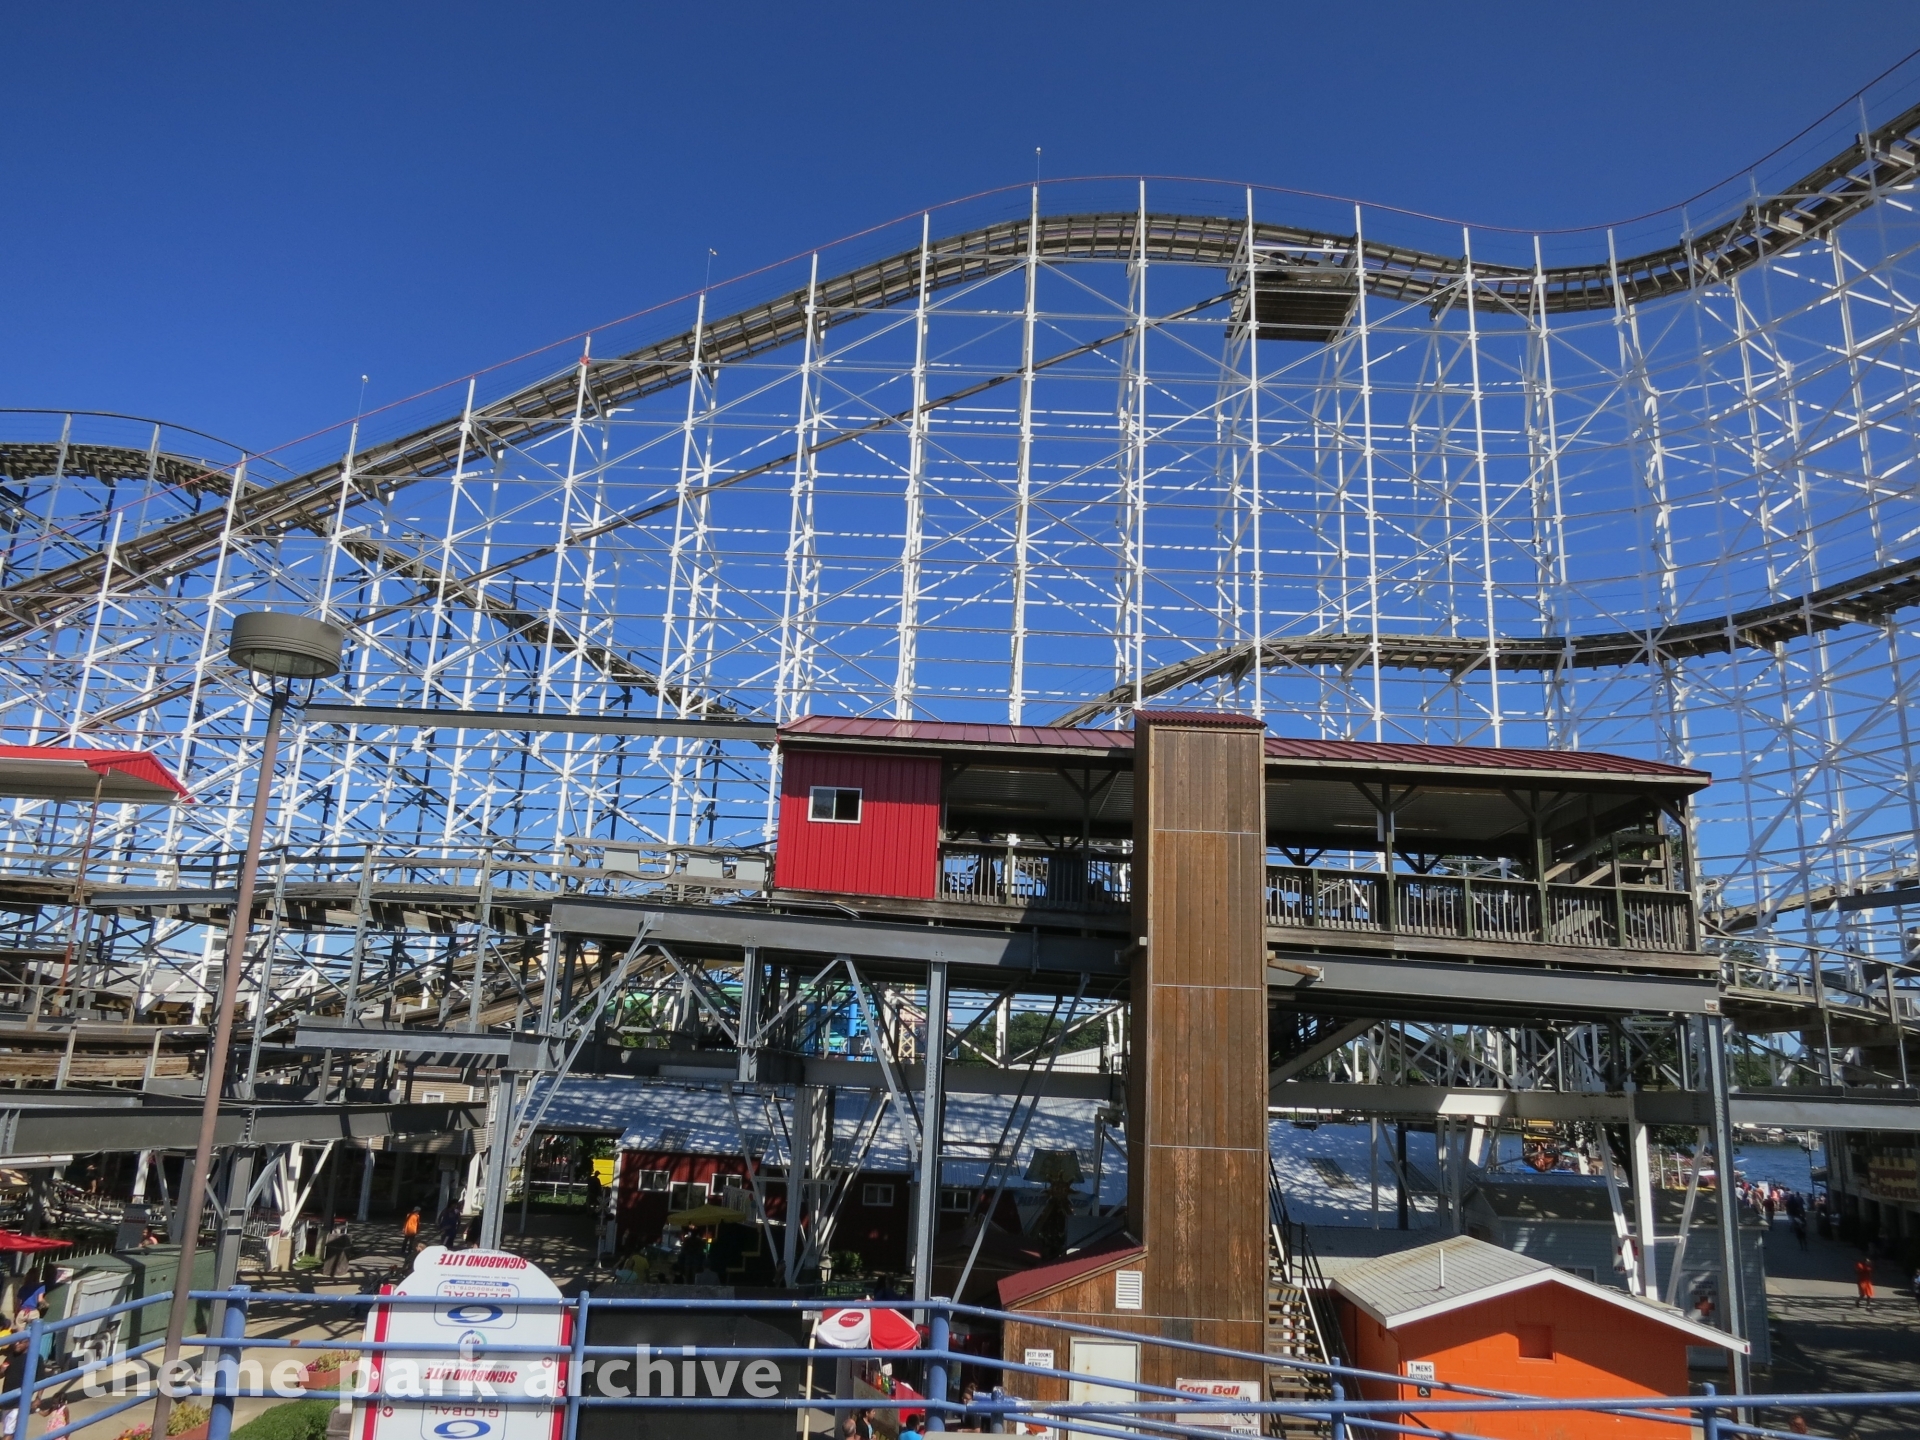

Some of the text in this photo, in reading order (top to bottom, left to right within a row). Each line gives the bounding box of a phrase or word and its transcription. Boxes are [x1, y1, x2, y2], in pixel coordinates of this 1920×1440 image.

[438, 1254, 527, 1269] SIGNABOND LITE
[424, 1367, 517, 1383] SIGNABOND LITE
[1180, 1385, 1240, 1395] Corn Ball
[430, 1406, 499, 1417] GLOBAL
[1233, 1428, 1258, 1437] ENTRANCE
